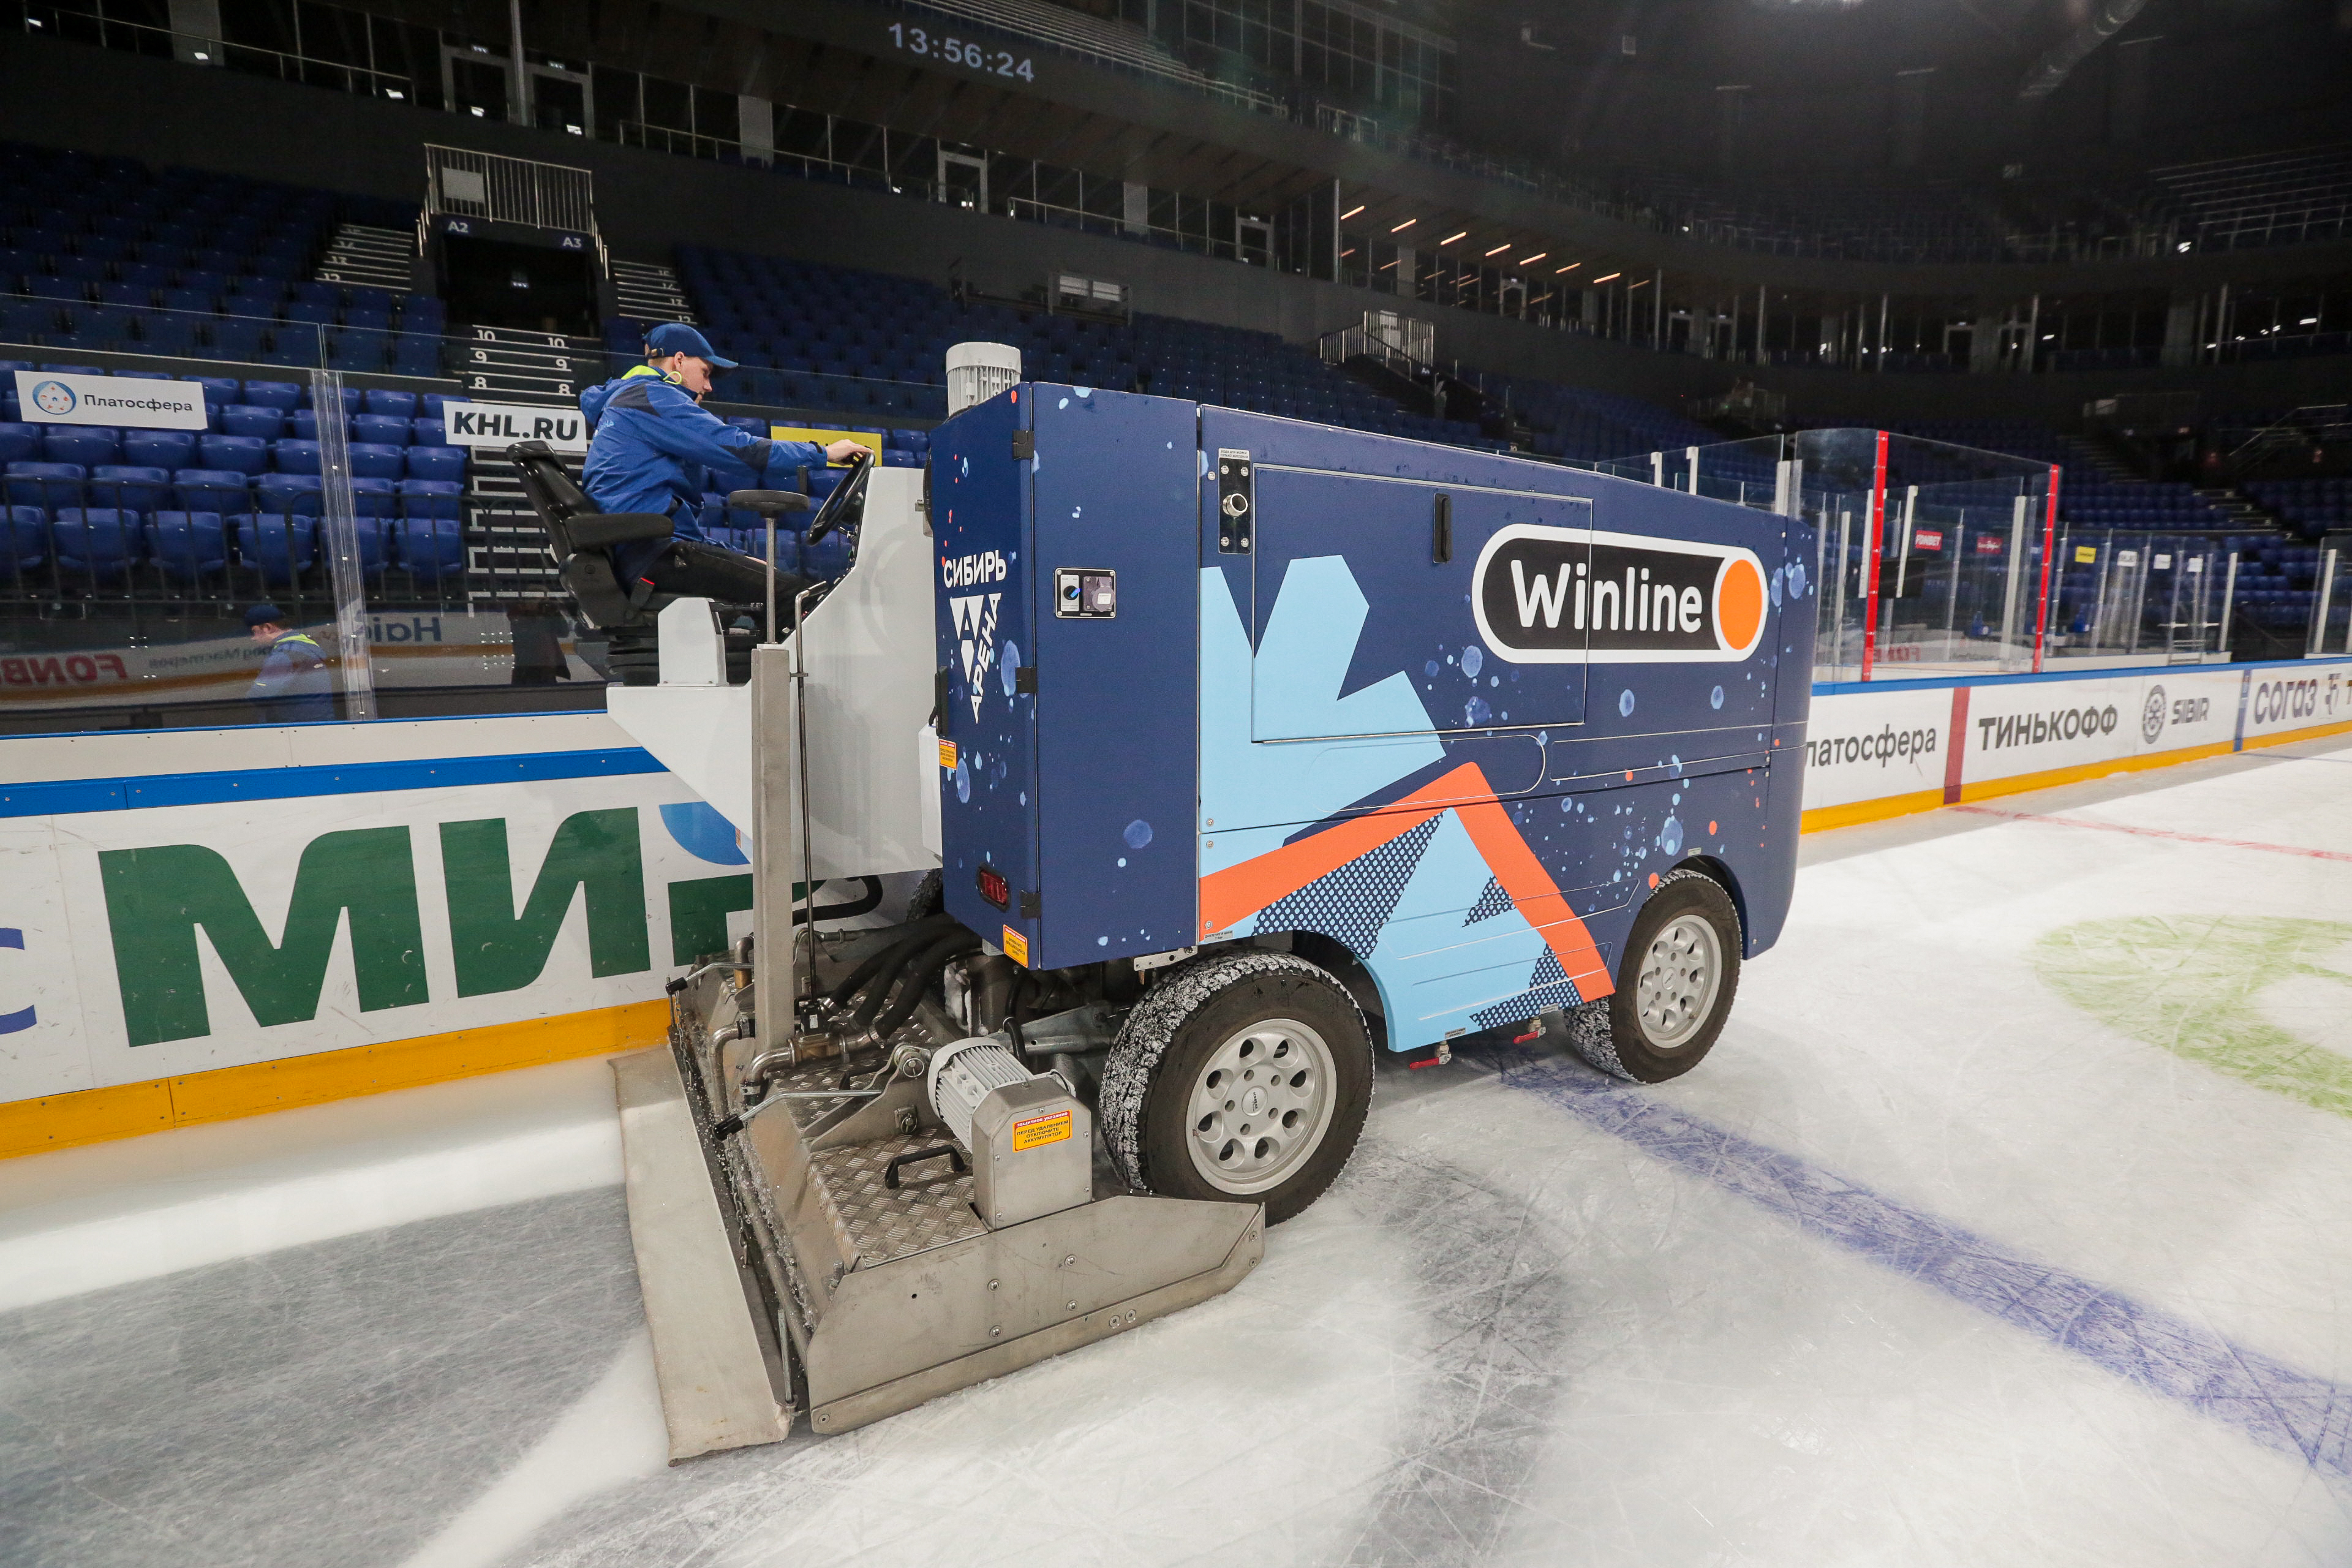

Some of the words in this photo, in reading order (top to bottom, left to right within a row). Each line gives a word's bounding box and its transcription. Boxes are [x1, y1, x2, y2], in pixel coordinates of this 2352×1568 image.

[889, 23, 1035, 83] 13:56:24
[477, 330, 496, 341] 10
[548, 337, 565, 348] 10
[475, 350, 488, 363] 9
[556, 358, 567, 371] 9
[475, 376, 488, 389] 8
[559, 383, 571, 394] 8
[84, 394, 192, 413] Платосфера
[454, 411, 578, 441] KHL.RU
[943, 549, 1006, 588] СИБИРЬ
[1510, 559, 1703, 633] Winline
[970, 592, 1002, 724] АРЕНА
[2171, 697, 2209, 725] SIBIR
[1978, 704, 2119, 751] ТИНЬКОФФ
[1017, 1117, 1043, 1127] защитное
[1044, 1112, 1068, 1121] указание
[1036, 1120, 1069, 1131] УДАЛЕНИЕМ
[1023, 1131, 1062, 1144] АККУМУЛЯТОР
[1026, 1127, 1059, 1138] ОТКЛЮЧИТЕ
